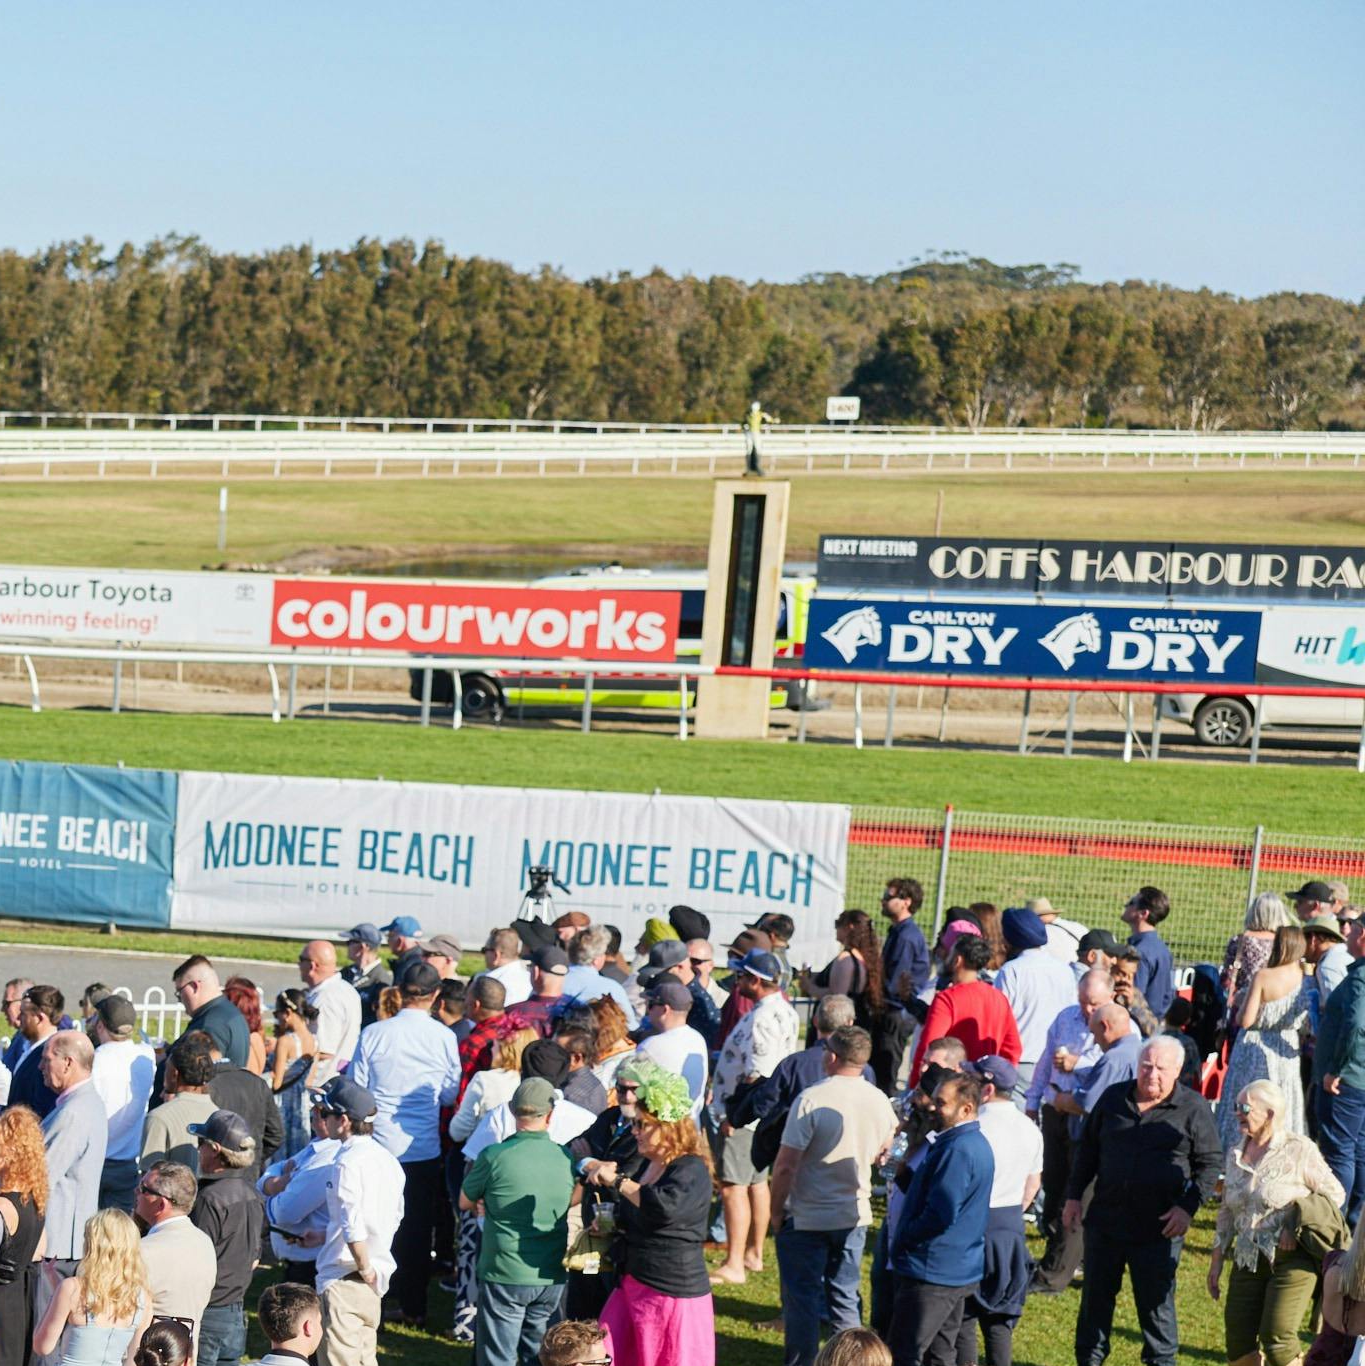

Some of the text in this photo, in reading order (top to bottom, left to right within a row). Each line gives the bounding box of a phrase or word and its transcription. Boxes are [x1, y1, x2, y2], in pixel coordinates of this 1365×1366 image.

[823, 539, 918, 557] NEXT MEETING
[929, 546, 1061, 581] COFFS
[1070, 549, 1288, 588] HARBOUR
[88, 578, 173, 607] Toyota
[0, 608, 77, 631] winning
[84, 611, 158, 634] feeling!
[277, 590, 667, 652] colourworks
[908, 610, 996, 627] CARLTON
[1129, 617, 1220, 633] CARLTON
[887, 624, 1019, 666] DRY
[1107, 631, 1245, 673] DRY
[1294, 636, 1337, 655] HIT
[58, 815, 147, 865] BEACH
[19, 857, 62, 871] HOTEL
[203, 820, 474, 888] MOONEE BEACH
[520, 838, 812, 908] MOONEE BEACH
[305, 883, 360, 897] HOTEL
[632, 901, 670, 915] HOT
